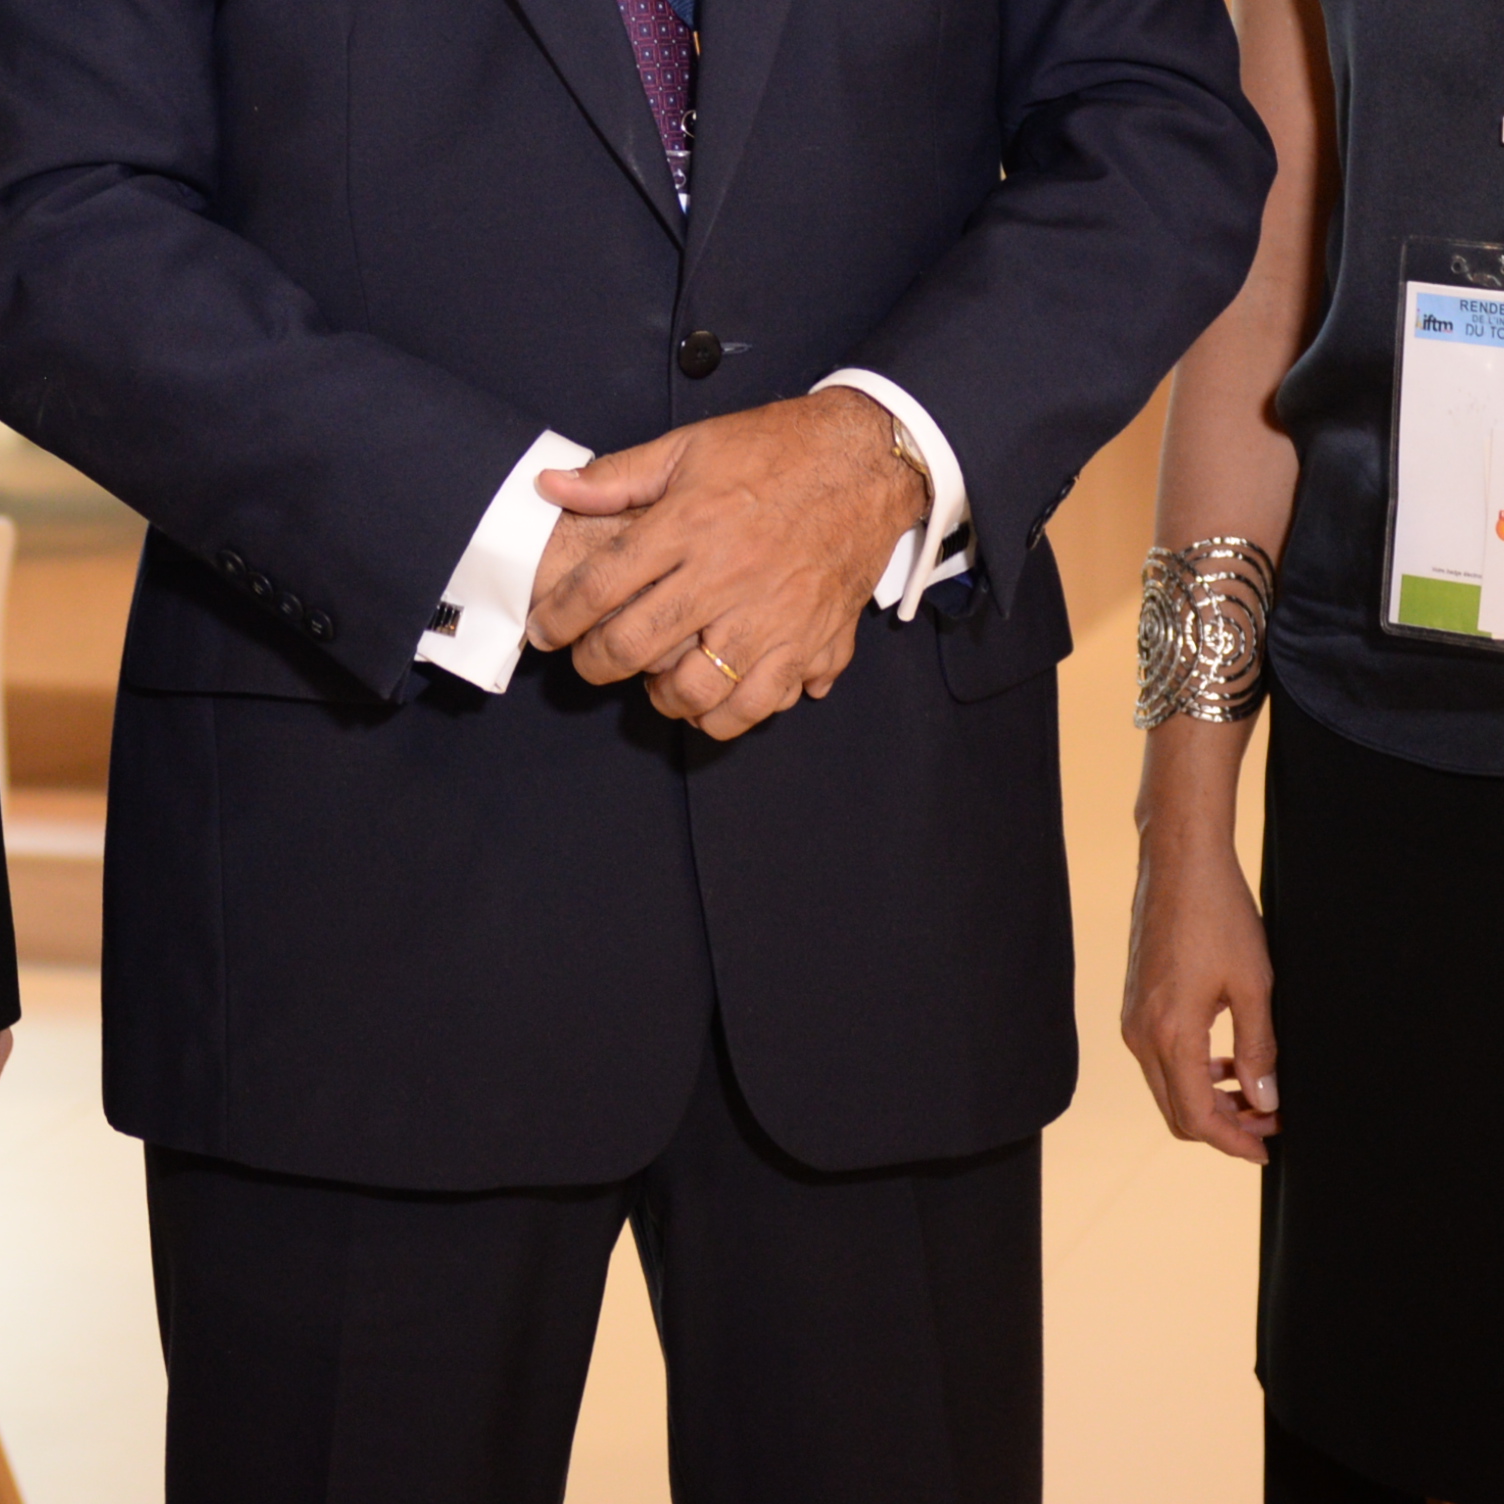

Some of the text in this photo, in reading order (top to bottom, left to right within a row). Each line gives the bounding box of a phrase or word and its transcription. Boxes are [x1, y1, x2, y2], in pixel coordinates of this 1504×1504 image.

[1422, 314, 1454, 333] iftm
[1472, 314, 1485, 324] DE
[1465, 324, 1485, 338] DU
